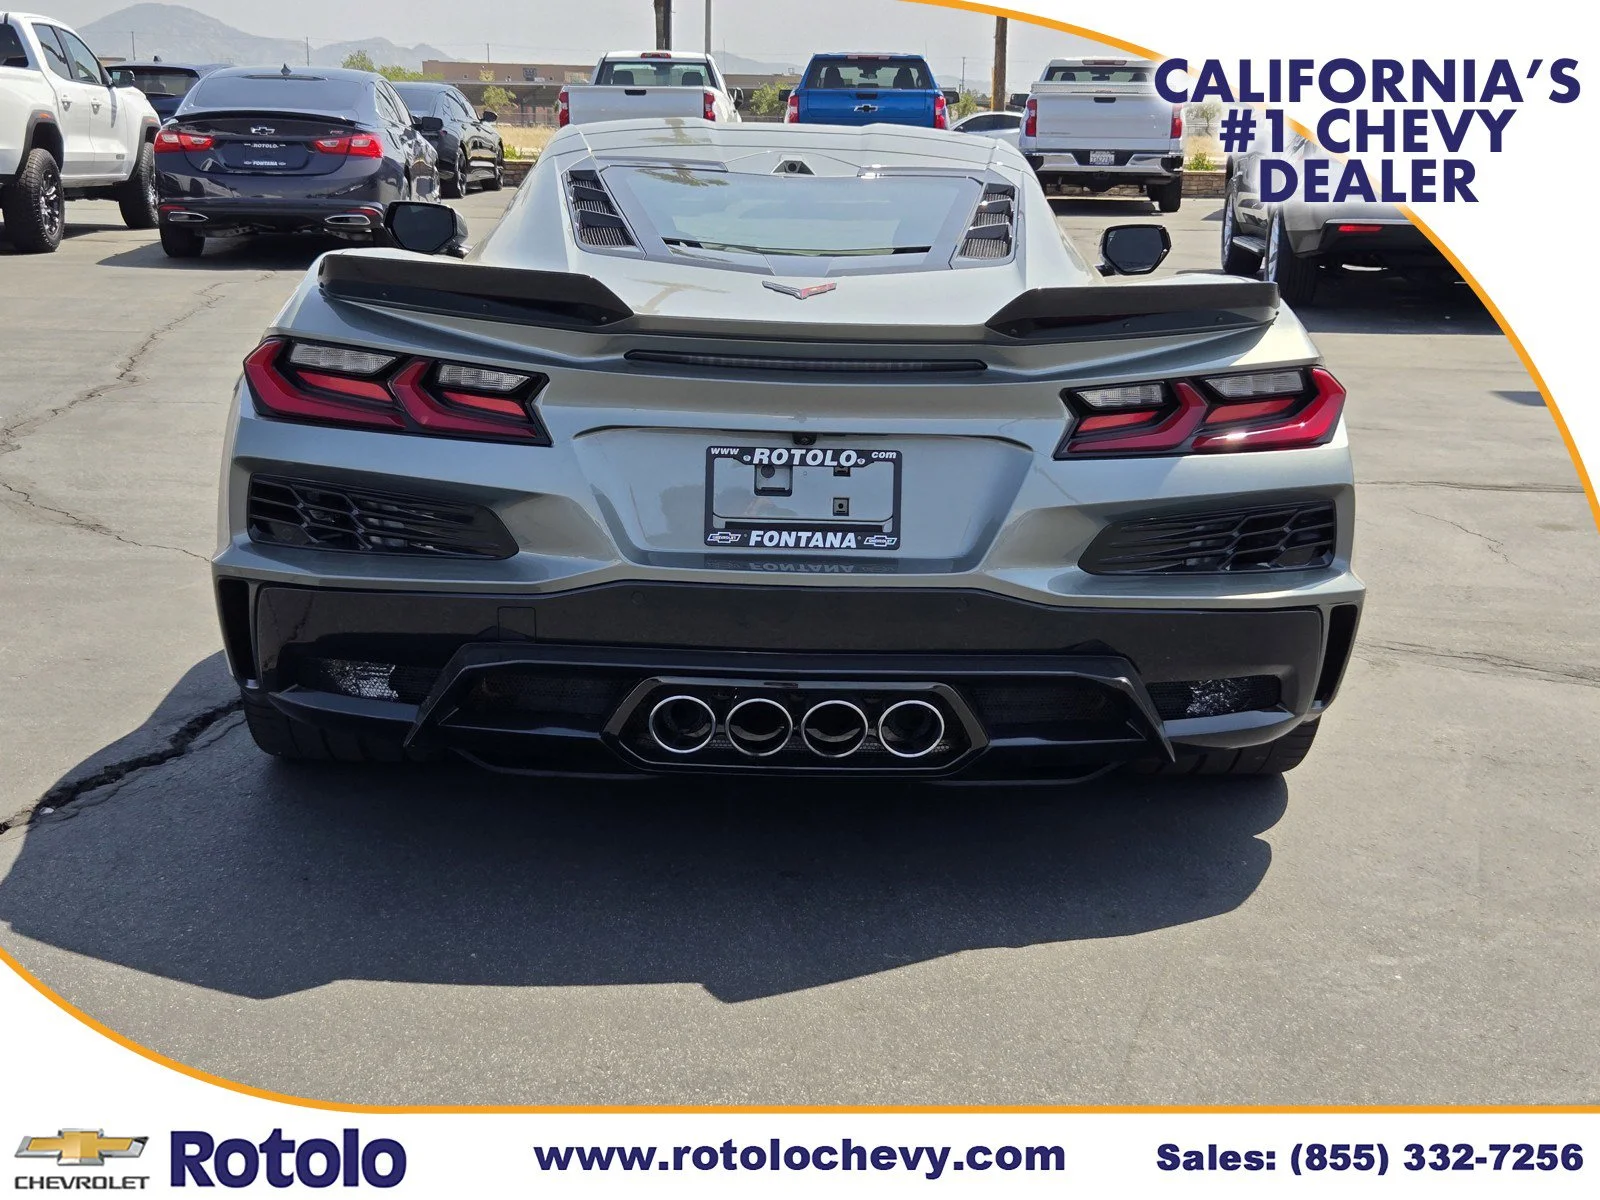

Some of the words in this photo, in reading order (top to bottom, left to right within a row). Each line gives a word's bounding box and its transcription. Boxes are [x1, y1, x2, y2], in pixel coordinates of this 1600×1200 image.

[752, 448, 858, 467] ROTOLO
[871, 450, 897, 459] com
[748, 530, 857, 548] FONTANA
